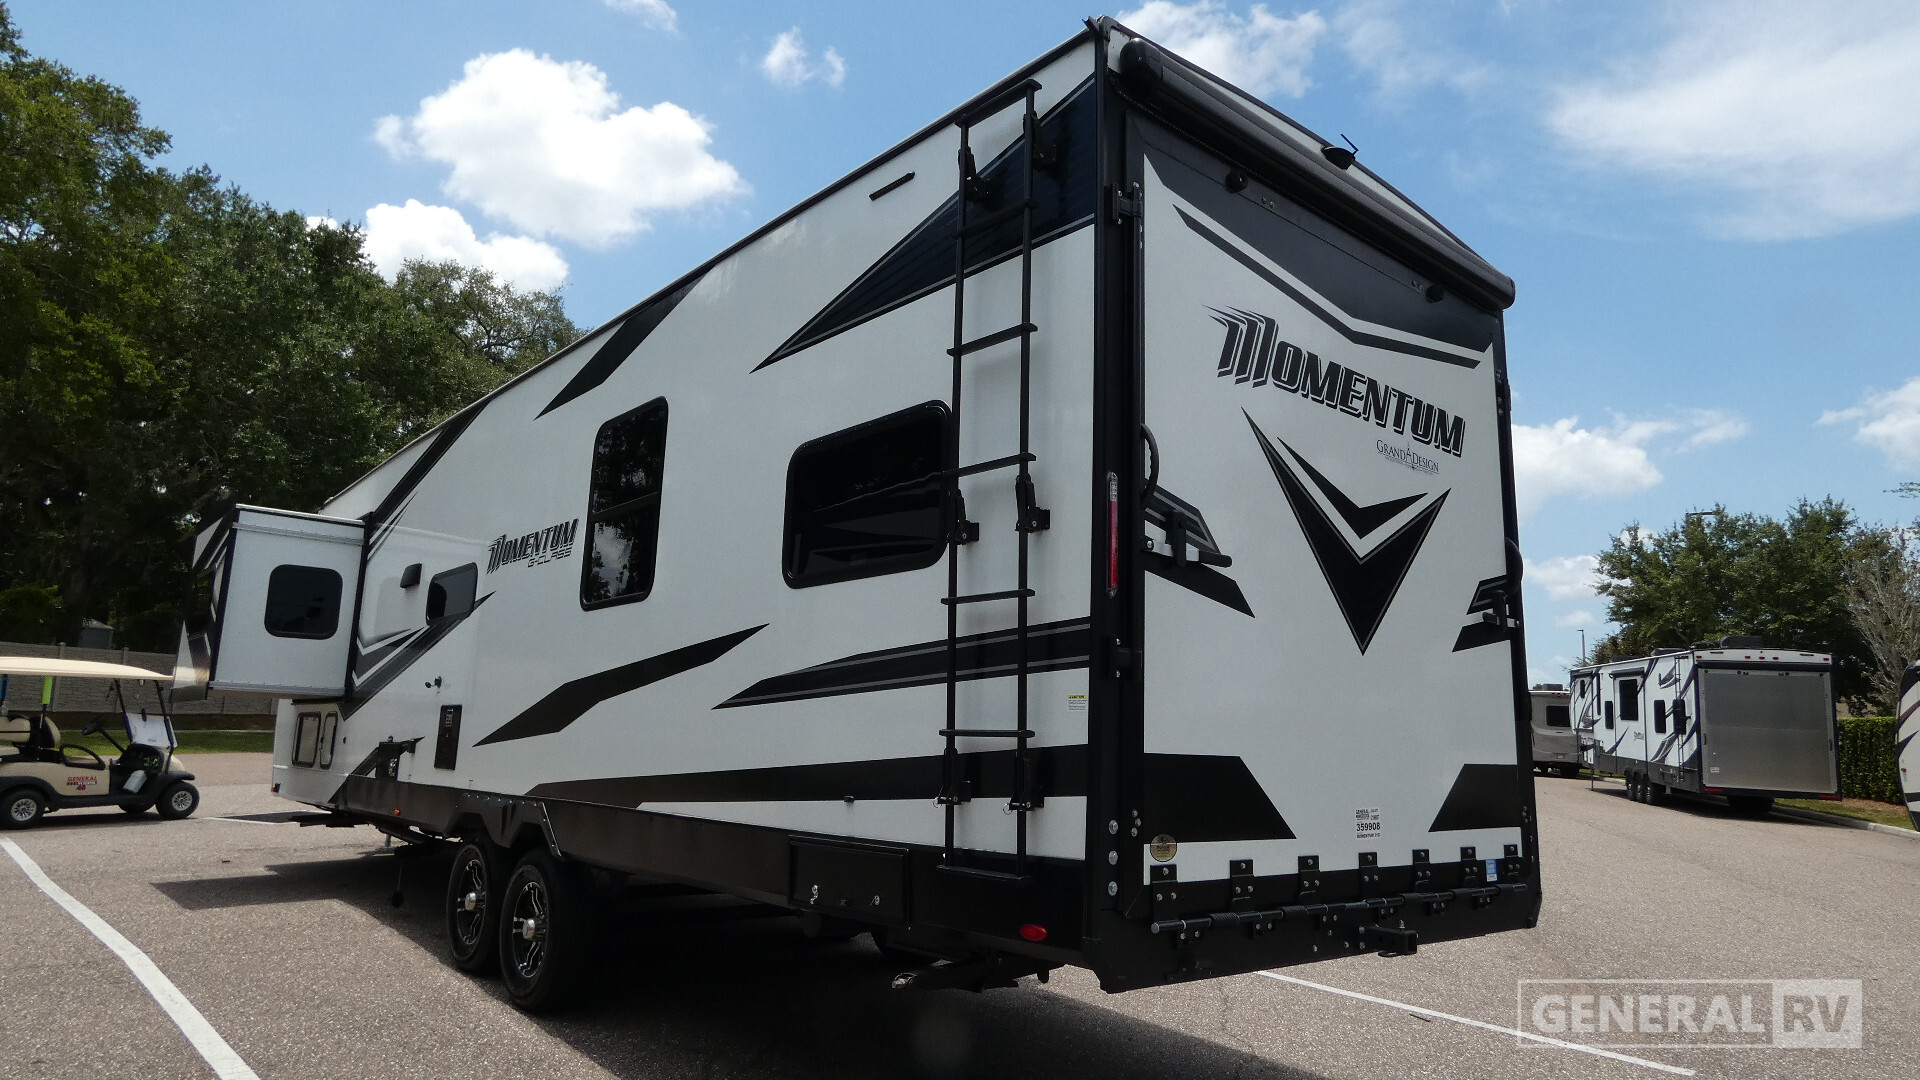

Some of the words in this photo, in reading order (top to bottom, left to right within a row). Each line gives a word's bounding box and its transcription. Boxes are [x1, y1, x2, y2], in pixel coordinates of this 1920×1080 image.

[1201, 304, 1466, 457] MOMENTUM
[1376, 439, 1406, 461] GRAND
[1412, 452, 1439, 472] DESIGN
[486, 518, 579, 575] MOMENTUM
